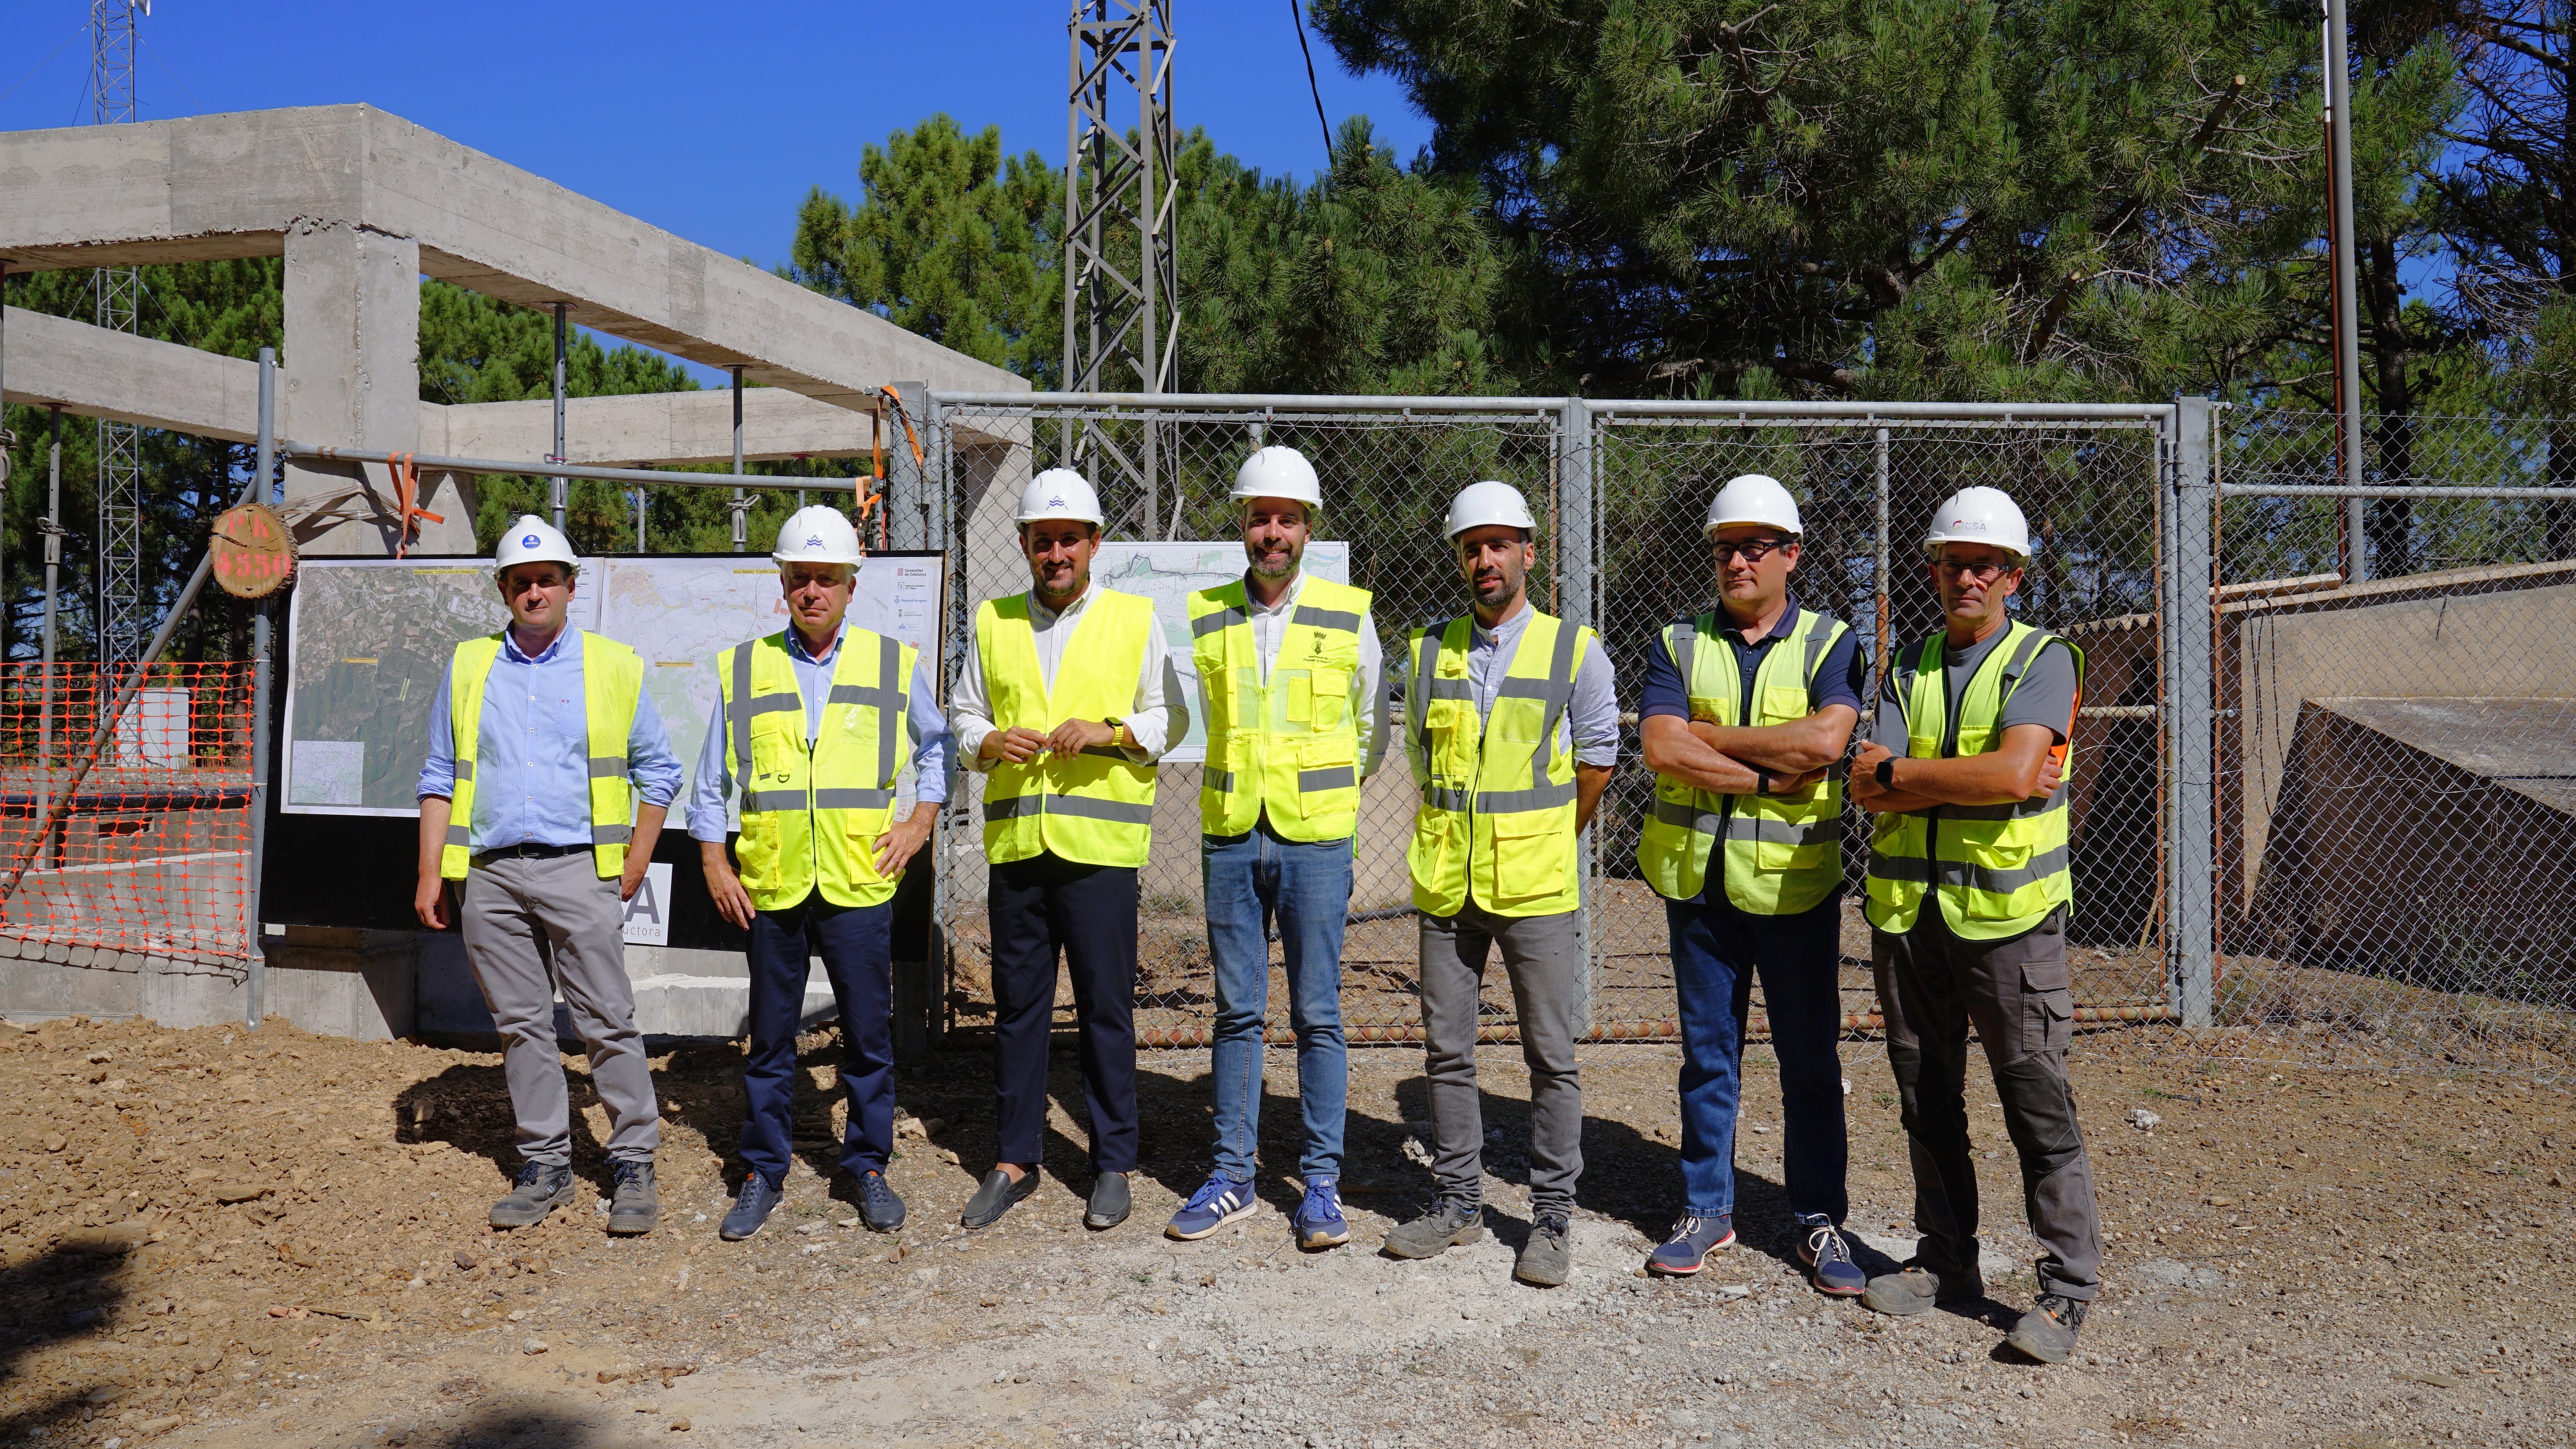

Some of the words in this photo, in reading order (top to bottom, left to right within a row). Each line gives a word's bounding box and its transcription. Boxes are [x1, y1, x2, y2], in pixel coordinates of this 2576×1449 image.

[214, 552, 292, 577] 4550
[624, 877, 660, 924] A
[622, 925, 660, 936] uctora
